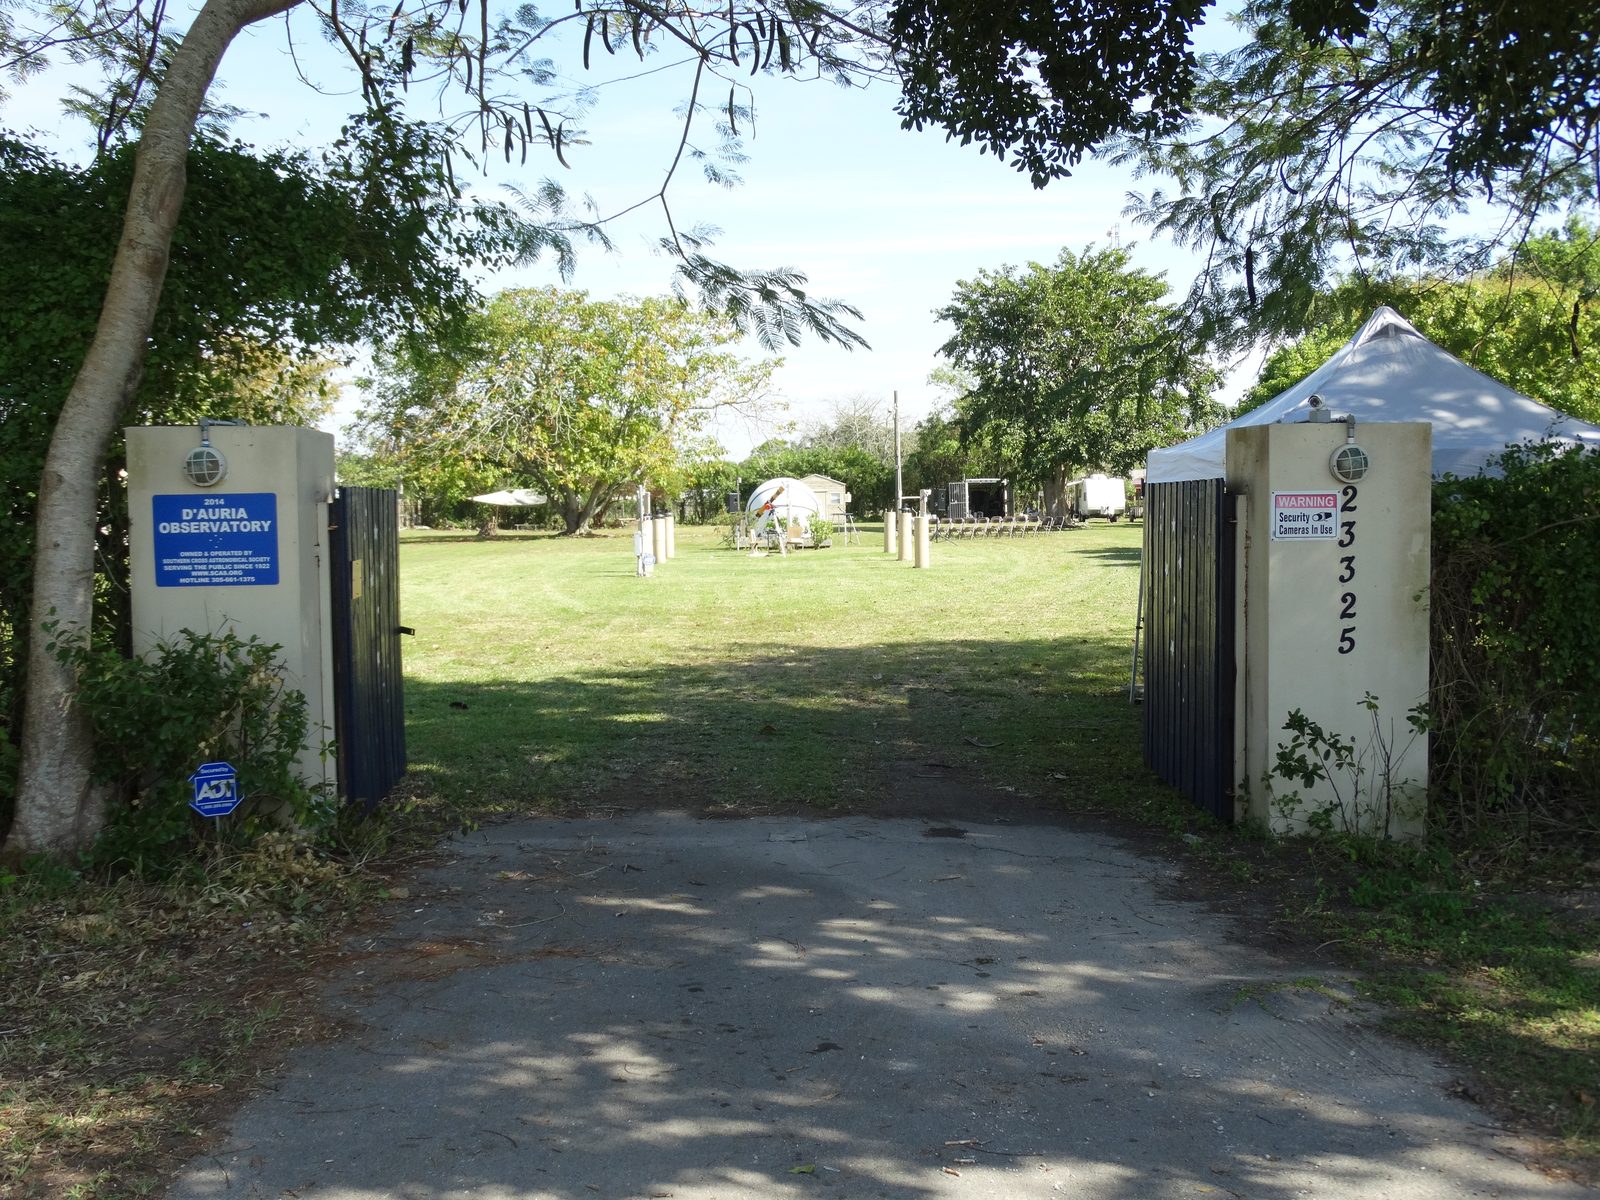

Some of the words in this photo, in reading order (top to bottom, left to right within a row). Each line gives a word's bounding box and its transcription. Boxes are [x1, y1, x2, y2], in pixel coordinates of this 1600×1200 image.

[204, 498, 225, 506] 2014
[1279, 496, 1334, 507] WARNING
[182, 507, 248, 520] D'AURIA
[1279, 512, 1310, 524] Security
[159, 520, 272, 534] OBSERVATORY
[1279, 524, 1310, 535] Cameras
[1311, 525, 1319, 535] In
[1320, 524, 1333, 535] Use
[1338, 485, 1358, 654] 23325
[197, 779, 235, 801] ADT
